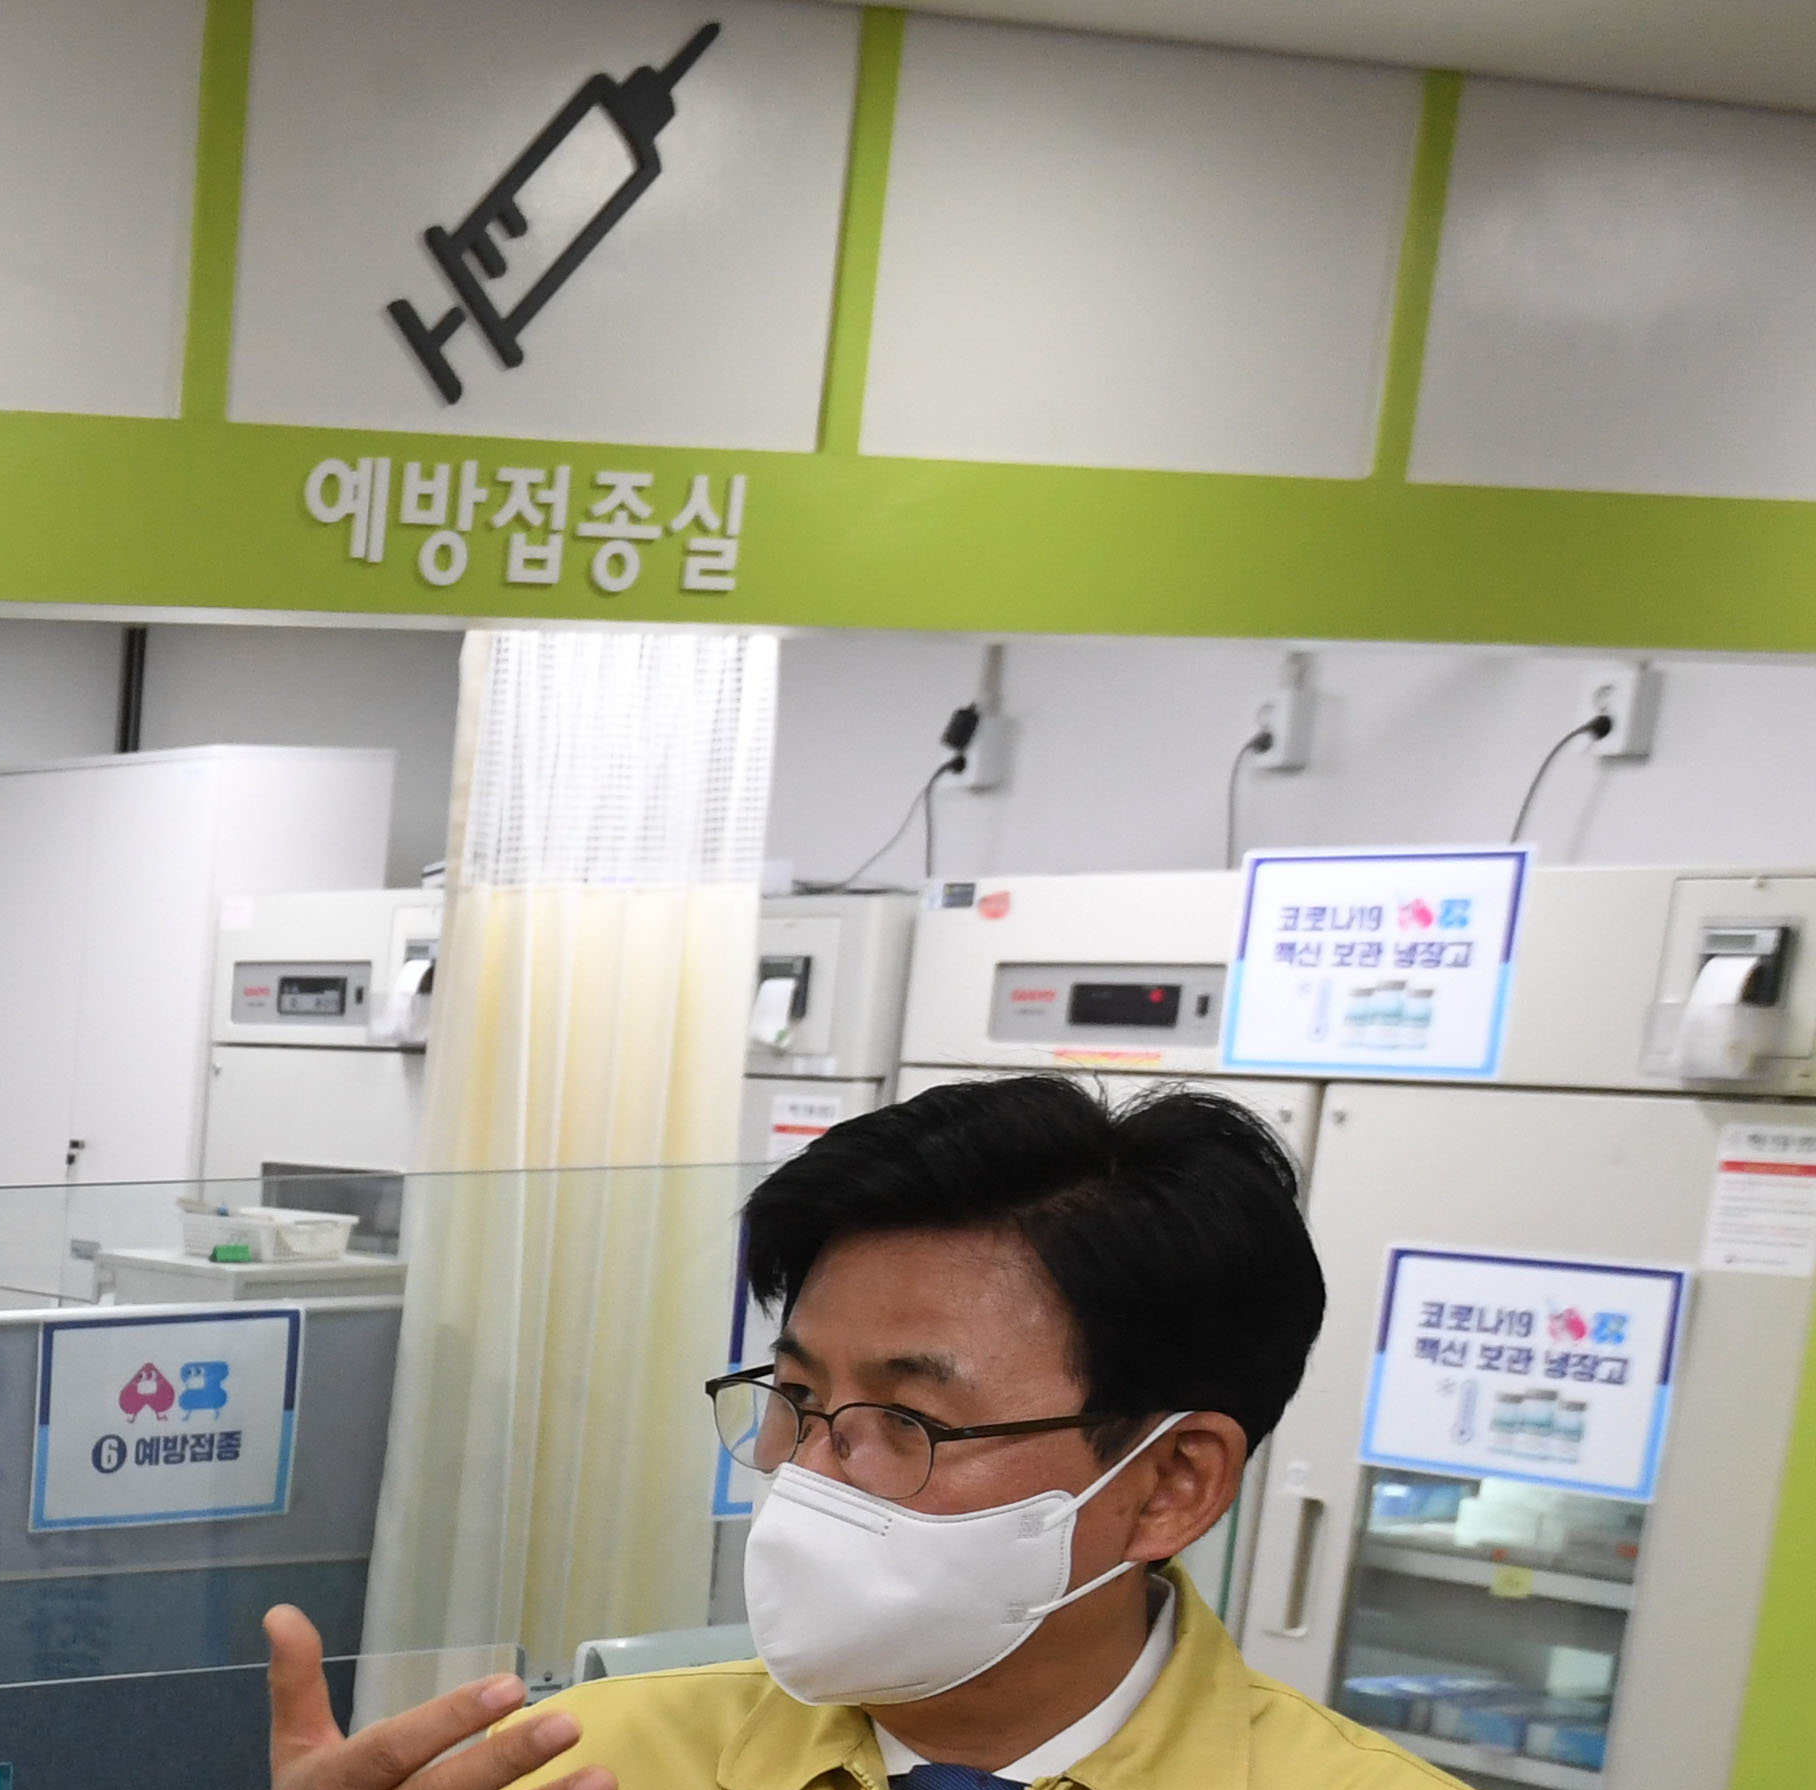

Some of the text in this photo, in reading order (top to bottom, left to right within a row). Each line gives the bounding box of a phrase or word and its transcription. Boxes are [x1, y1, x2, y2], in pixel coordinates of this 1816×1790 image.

[304, 456, 747, 593] 예방접종실
[1278, 905, 1384, 932] 코로나19
[1274, 941, 1475, 969] 백신 보관 냉장고
[1418, 1301, 1535, 1338] 코로나19
[1414, 1336, 1630, 1386] 백신 보관 냉장고
[133, 1430, 242, 1467] 예방접종
